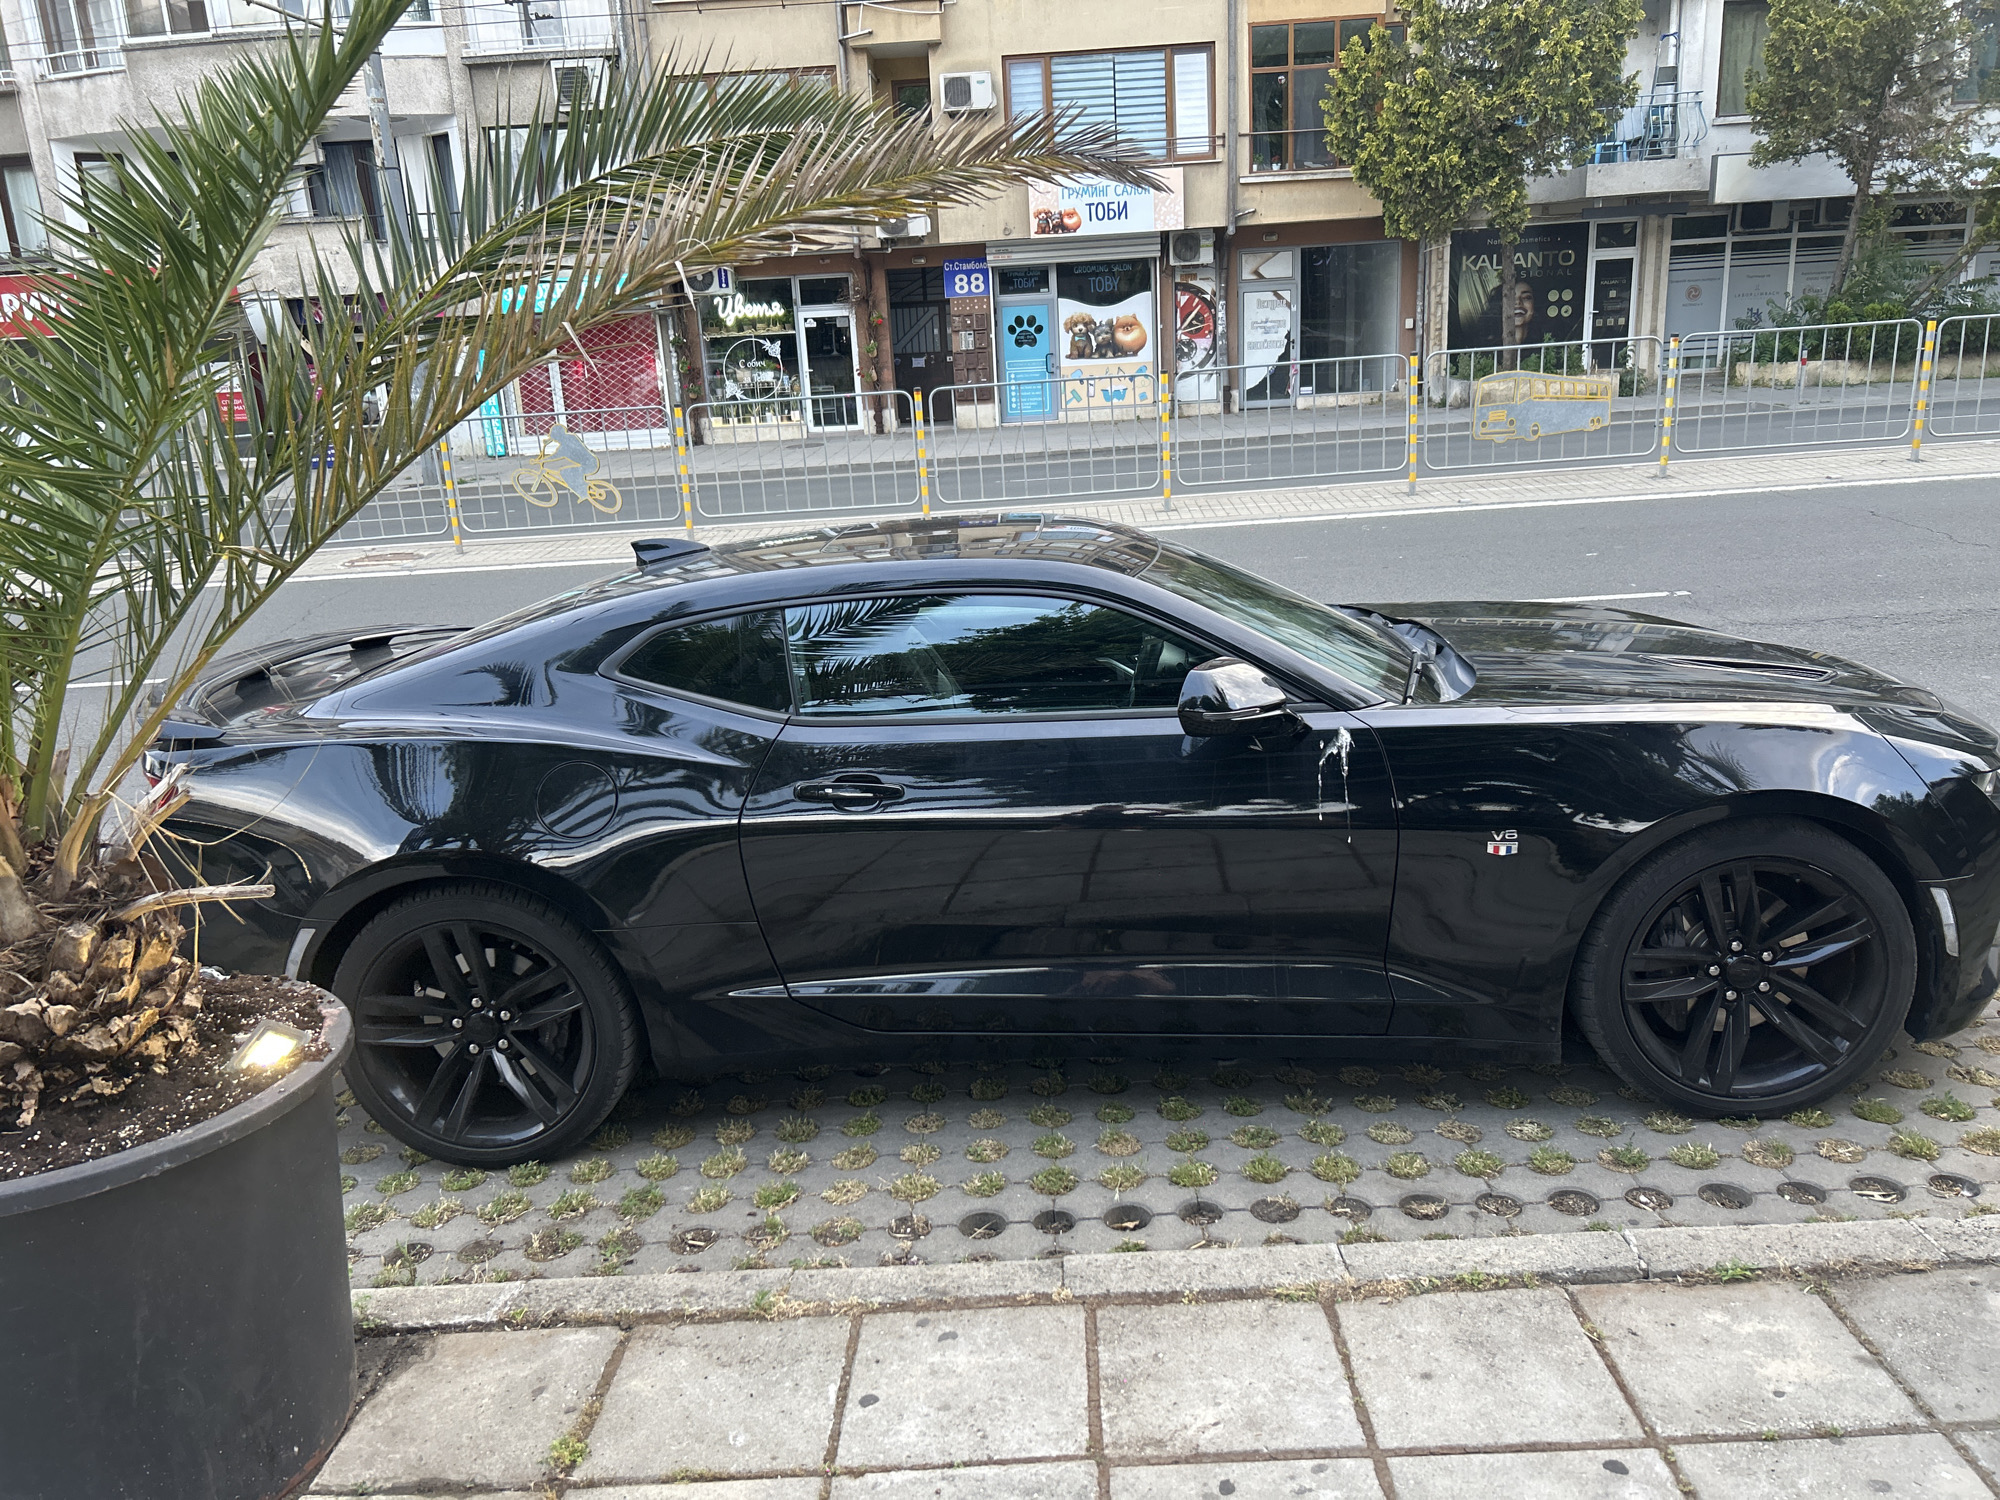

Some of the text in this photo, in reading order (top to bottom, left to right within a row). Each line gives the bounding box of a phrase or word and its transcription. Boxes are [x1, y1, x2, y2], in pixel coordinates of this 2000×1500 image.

[1061, 184, 1151, 200] ГРУМИНГ САЛОН
[1085, 201, 1128, 222] ТОБИ
[1519, 236, 1551, 244] osmetics
[944, 261, 989, 272] Ст.Стамболо
[1462, 249, 1575, 271] KALANTO
[1074, 263, 1132, 274] GROOMING SALON
[954, 273, 985, 294] 88
[1088, 275, 1121, 293] TOBY
[714, 293, 785, 326] Цветя
[739, 358, 767, 369] С обич
[1491, 829, 1518, 841] V6
